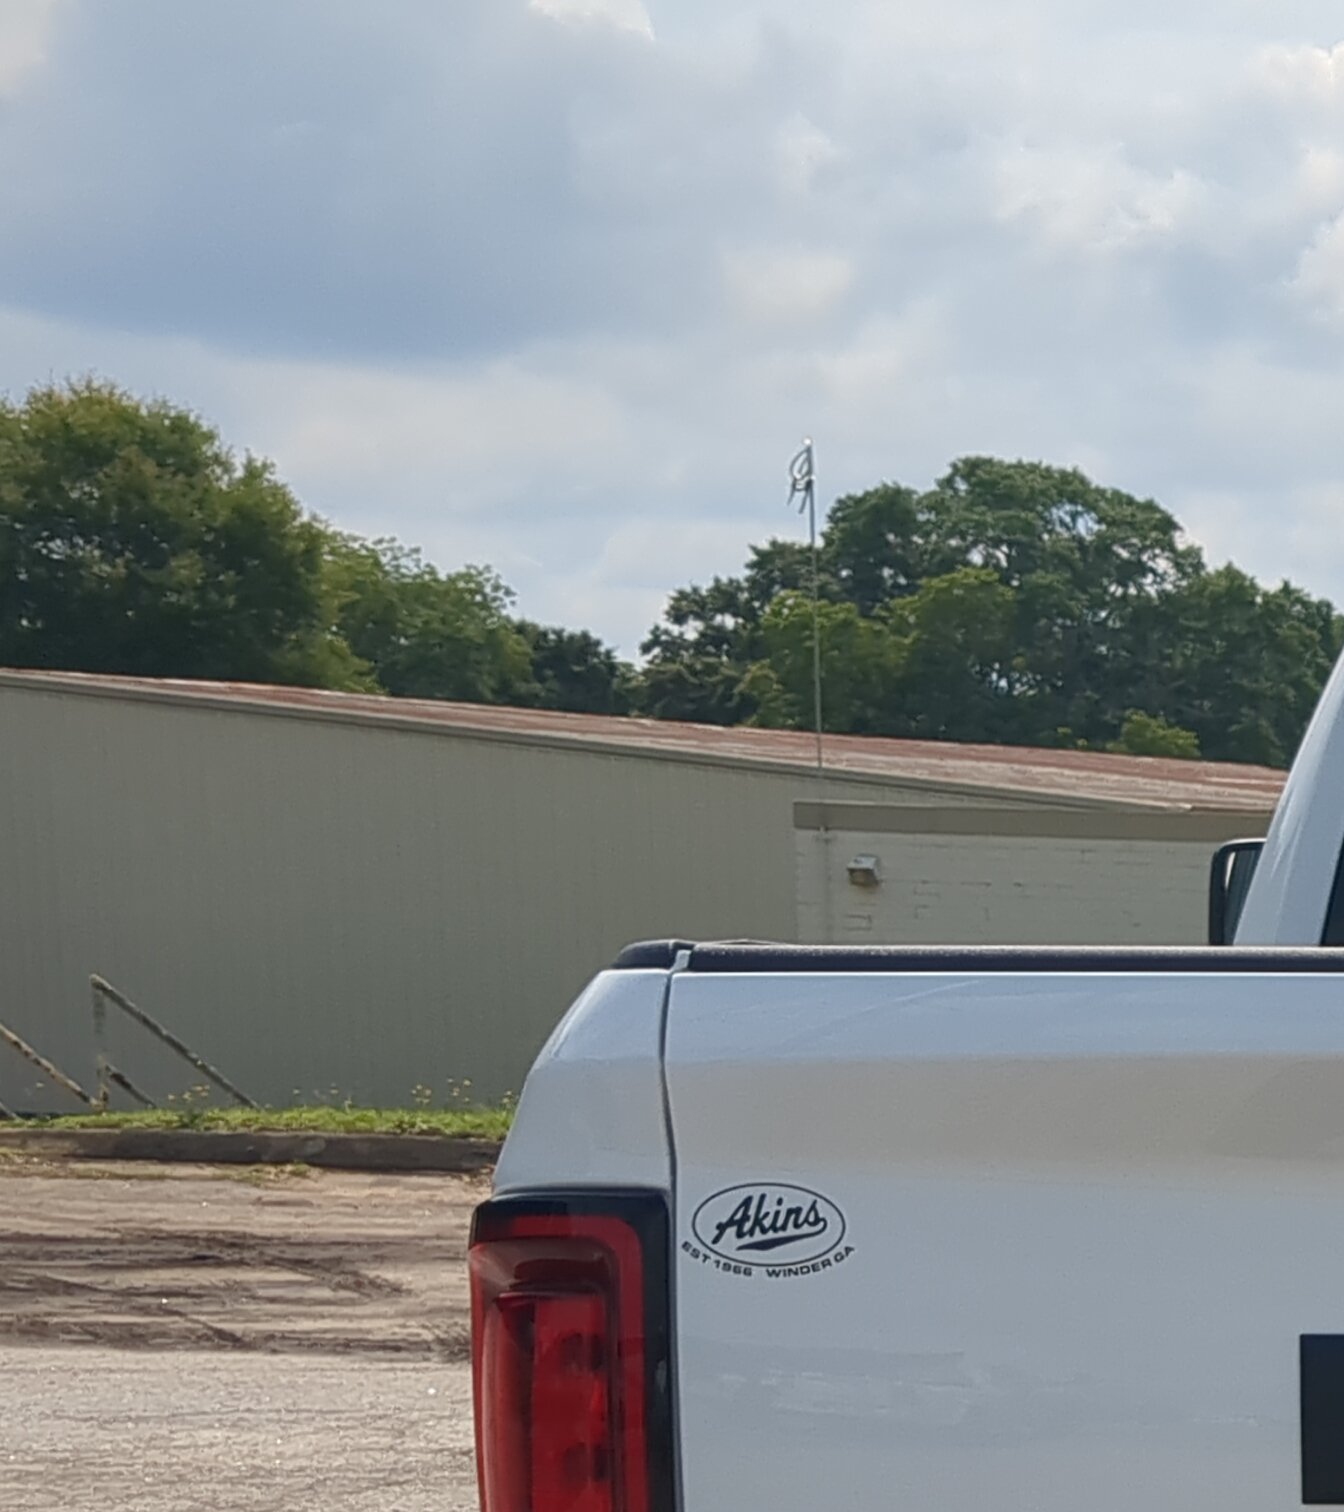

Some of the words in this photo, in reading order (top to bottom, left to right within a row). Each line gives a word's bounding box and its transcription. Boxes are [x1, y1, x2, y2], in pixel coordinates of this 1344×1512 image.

[711, 1193, 828, 1249] Akins
[681, 1241, 712, 1264] EST
[714, 1259, 753, 1277] 1966
[766, 1257, 833, 1278] WINDER
[834, 1245, 855, 1263] GA
